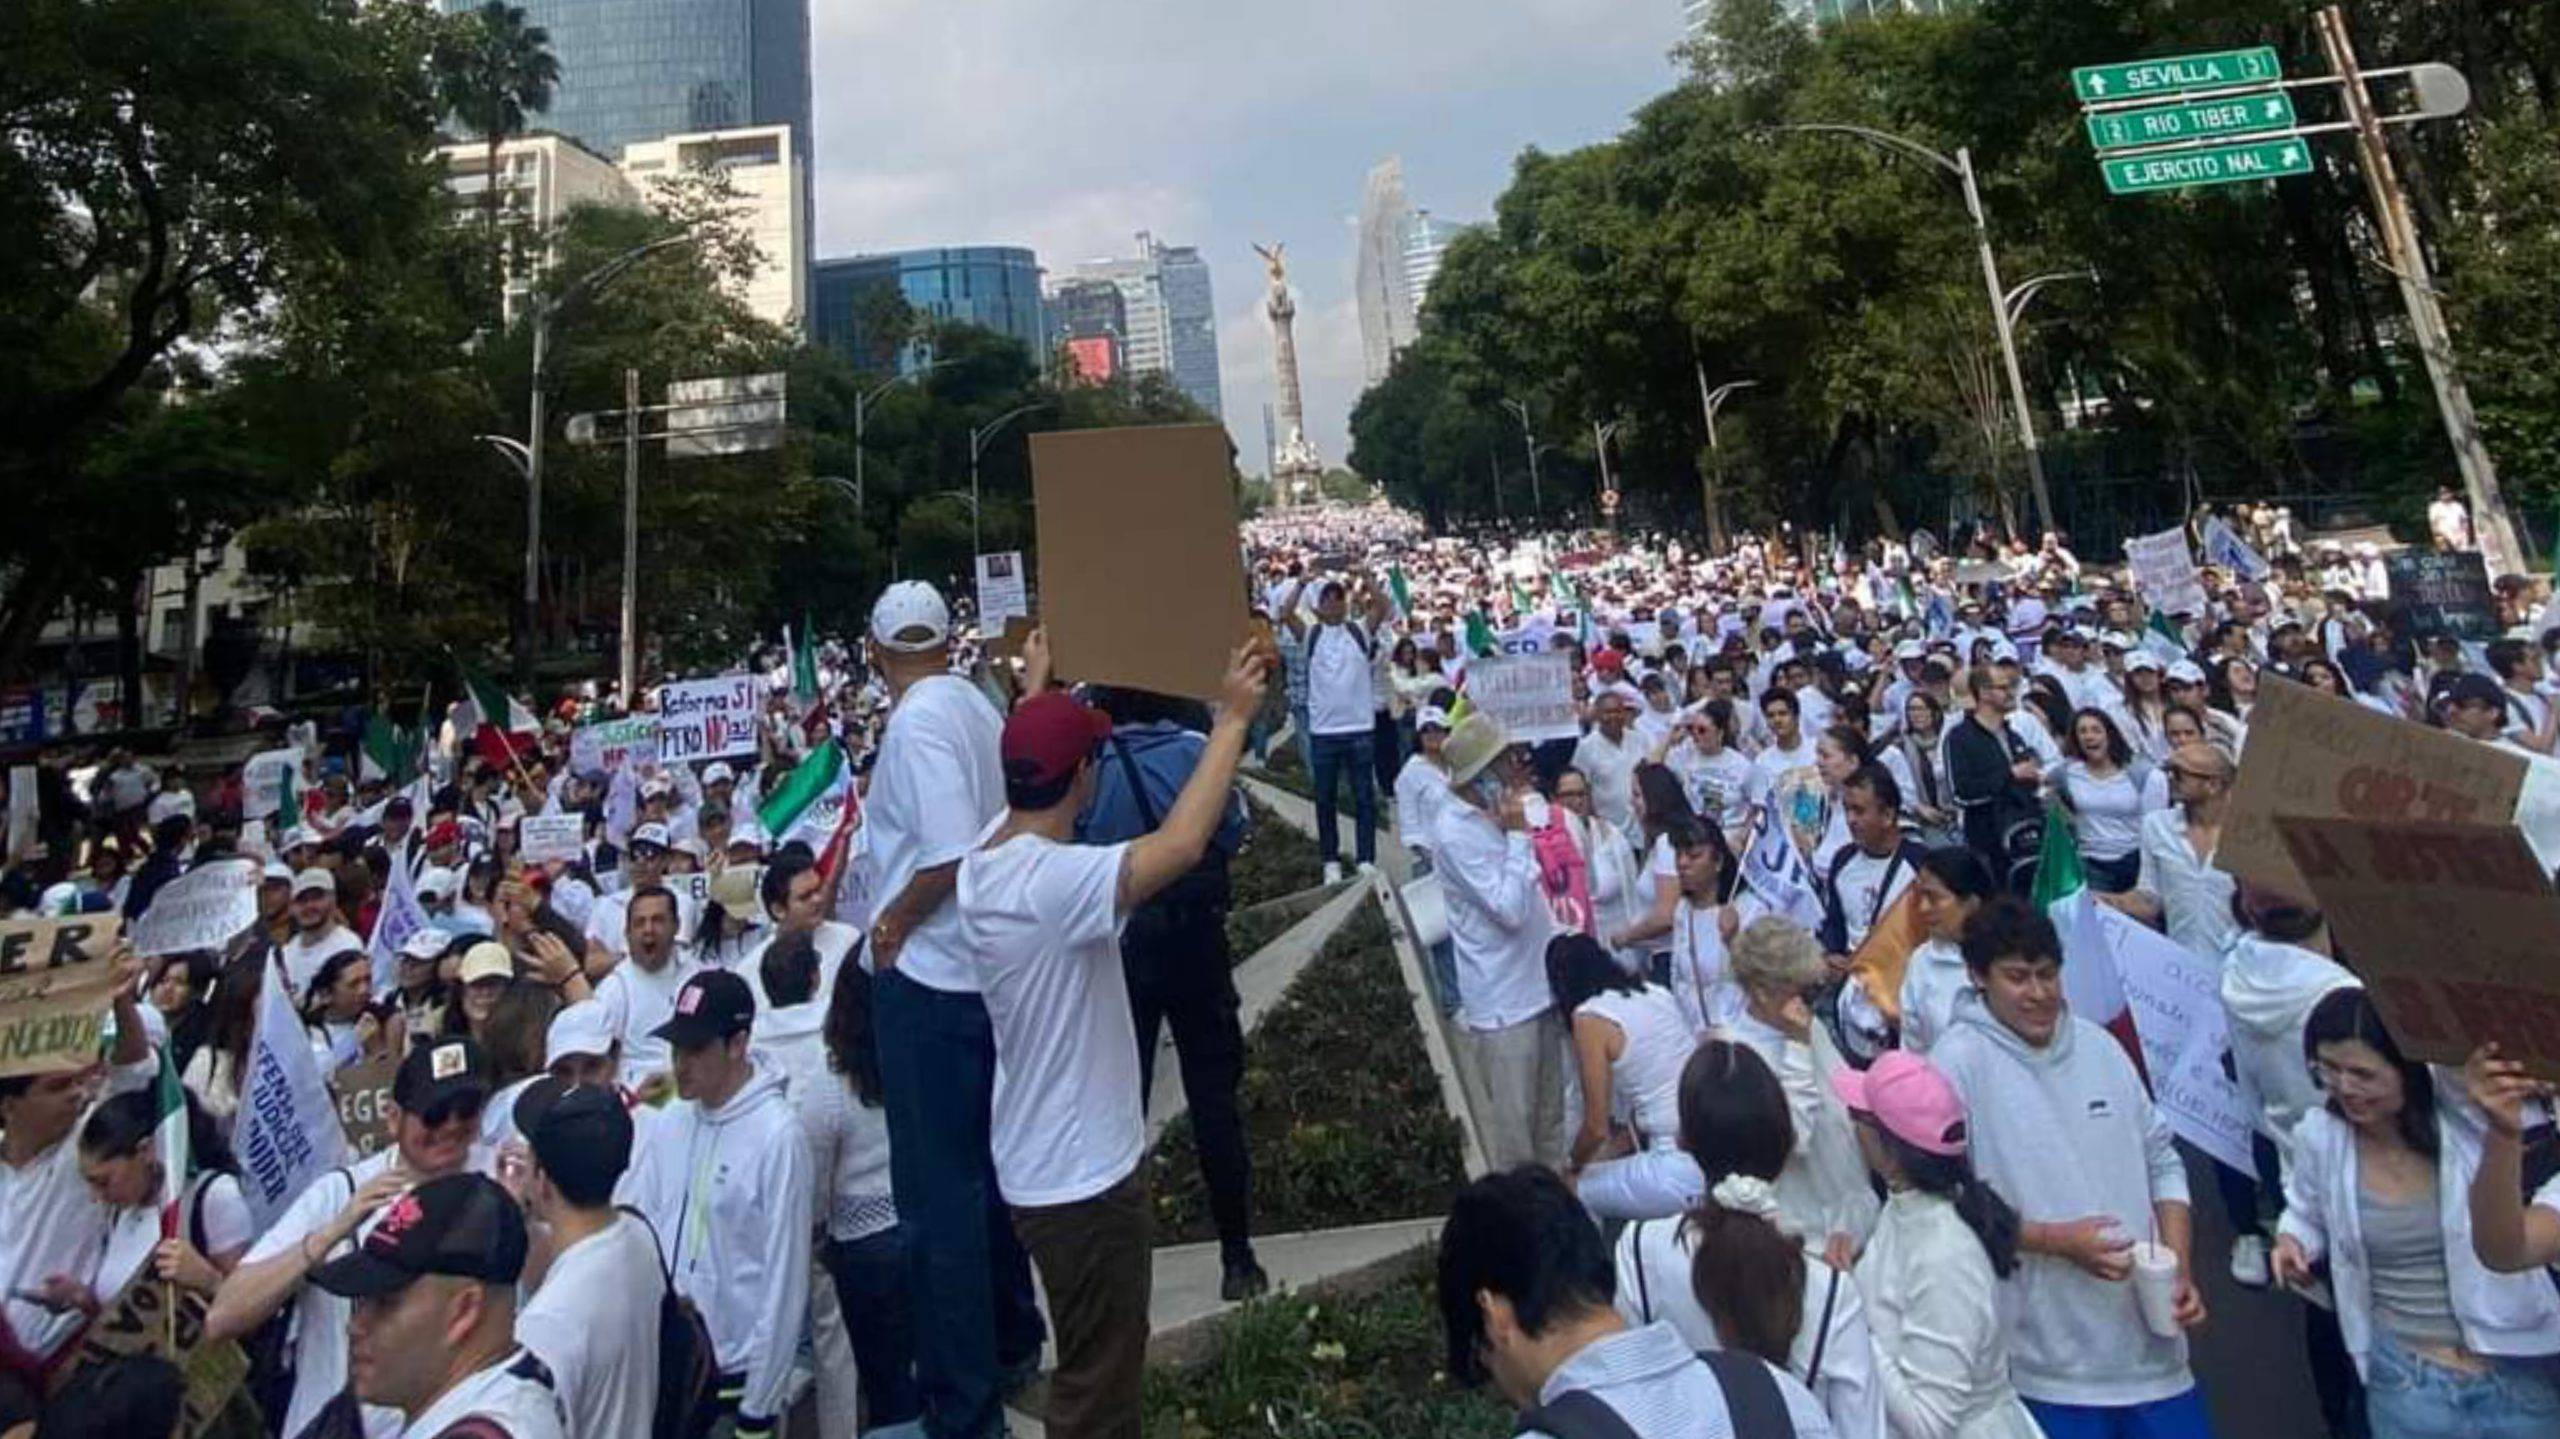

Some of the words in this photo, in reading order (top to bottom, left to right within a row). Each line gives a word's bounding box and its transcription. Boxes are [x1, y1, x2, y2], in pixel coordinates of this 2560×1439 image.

[2126, 60, 2222, 89] SEVILLA
[2144, 113, 2181, 136] RIO
[2188, 105, 2249, 130] TIBER
[2123, 155, 2218, 184] EJERCITO
[2226, 150, 2270, 173] NAL
[661, 687, 728, 718] Reforma
[661, 725, 702, 758] PERO
